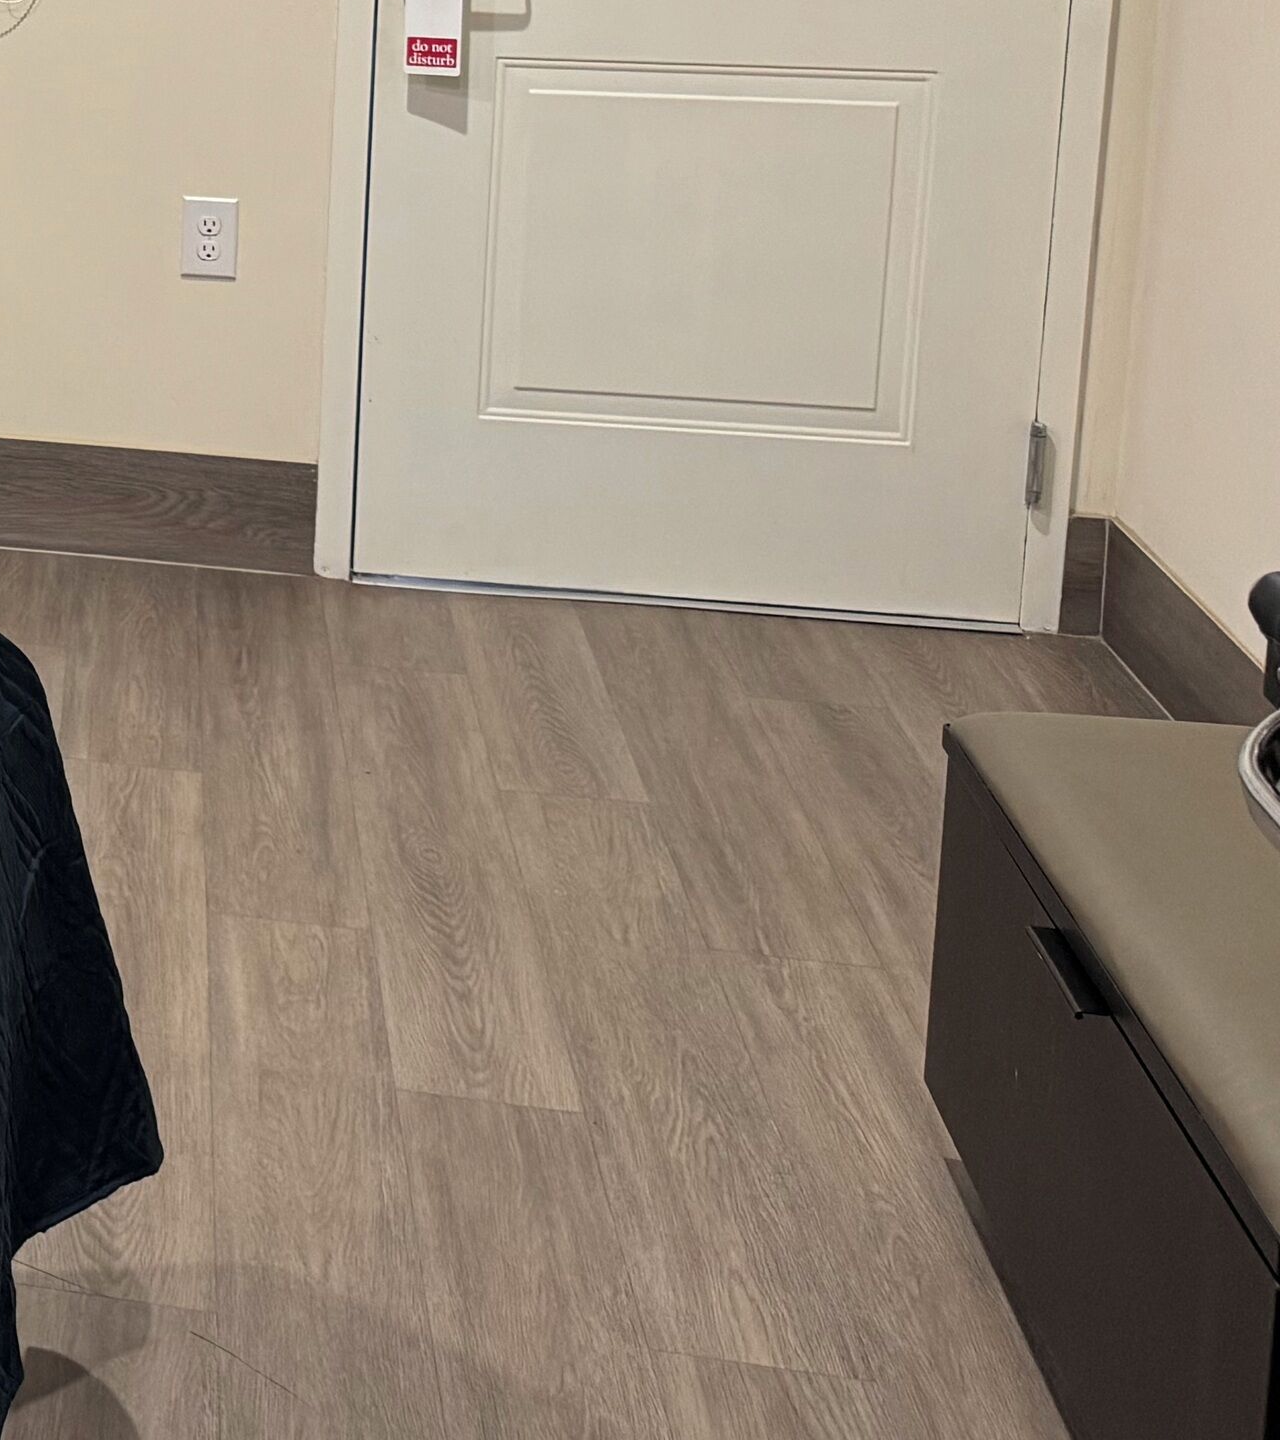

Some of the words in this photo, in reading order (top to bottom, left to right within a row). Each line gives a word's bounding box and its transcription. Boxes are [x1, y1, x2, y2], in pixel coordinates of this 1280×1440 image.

[412, 39, 428, 51] do
[432, 44, 452, 53] not
[409, 53, 455, 66] disturb
